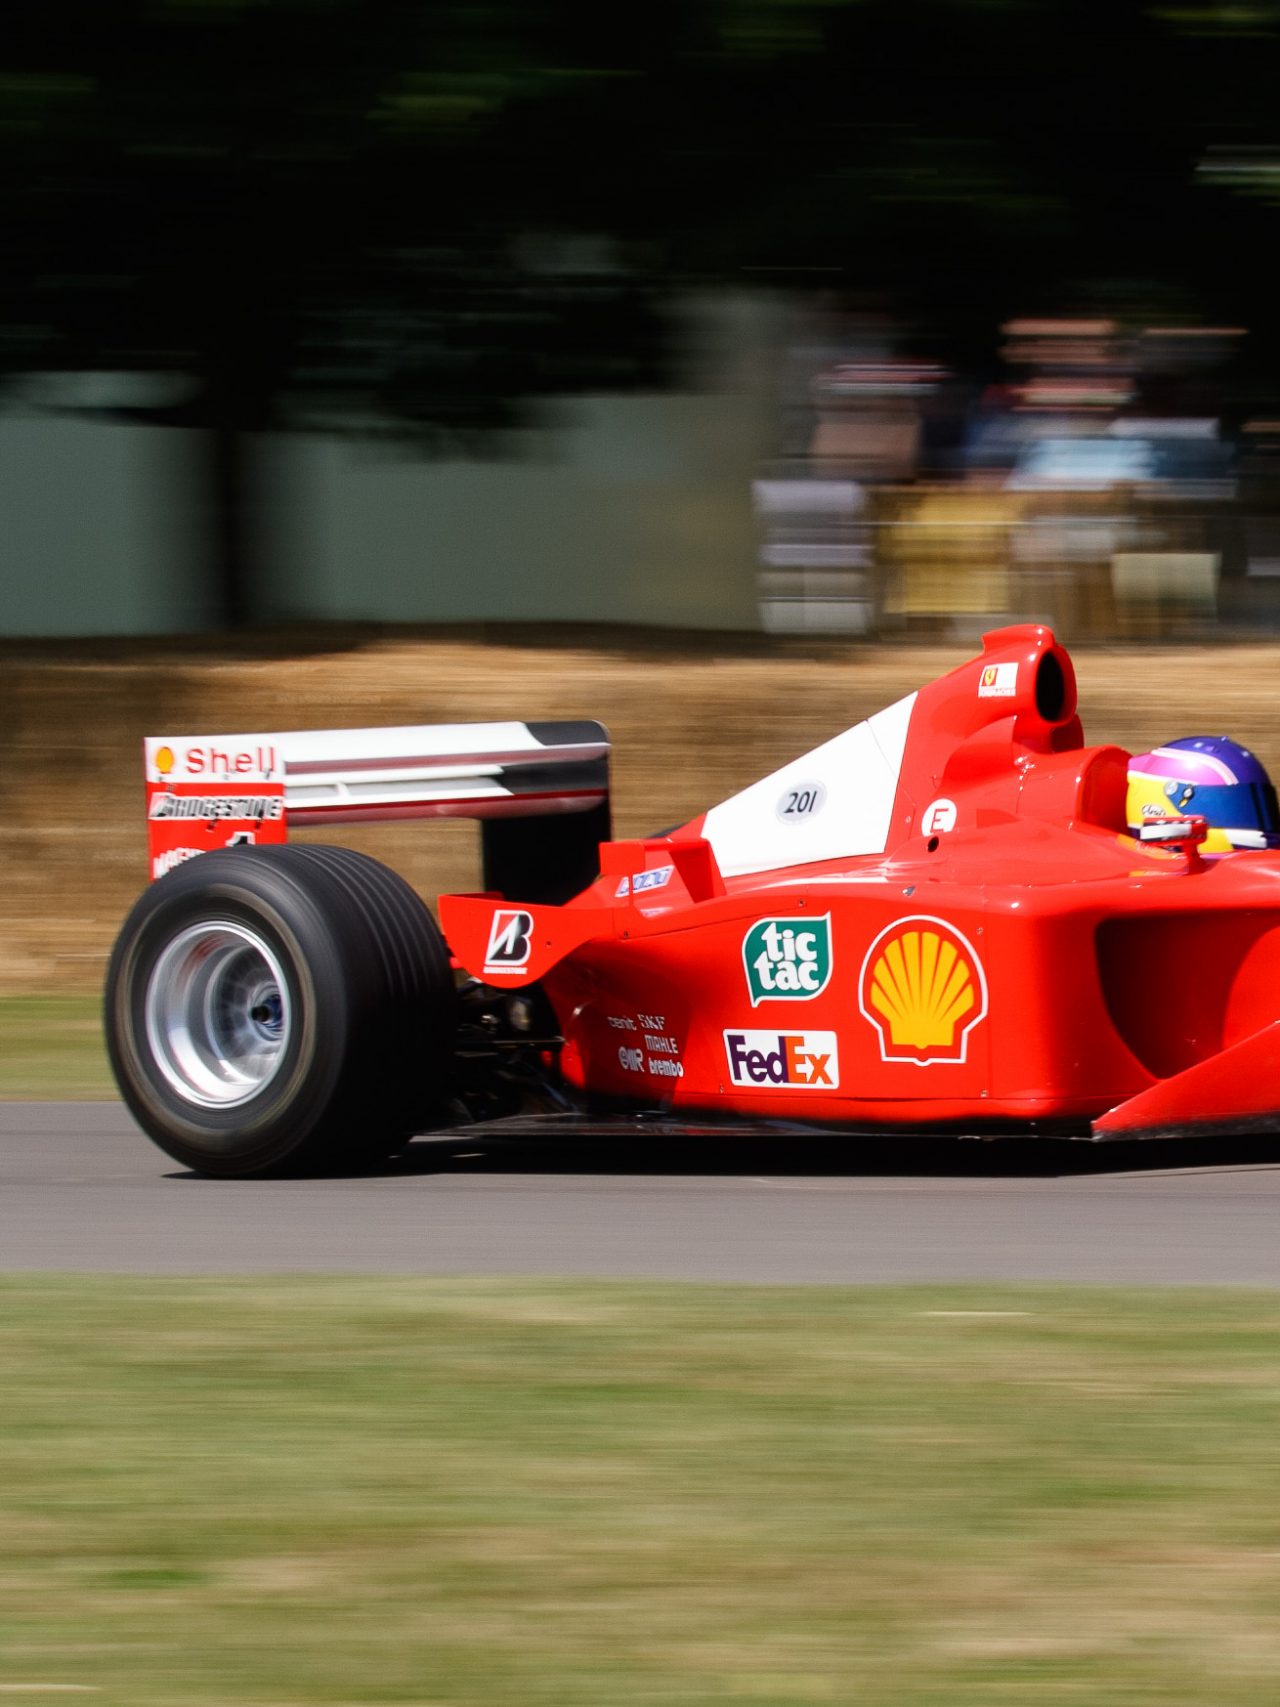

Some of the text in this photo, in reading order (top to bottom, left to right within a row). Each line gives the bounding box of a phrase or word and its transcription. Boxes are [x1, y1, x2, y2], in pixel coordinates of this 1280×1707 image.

[185, 747, 275, 773] Shell
[784, 791, 817, 813] 201
[930, 808, 949, 833] E
[761, 922, 817, 961] tic
[753, 951, 819, 990] tac
[644, 1034, 678, 1053] MAHLE
[727, 1034, 832, 1084] FedEx
